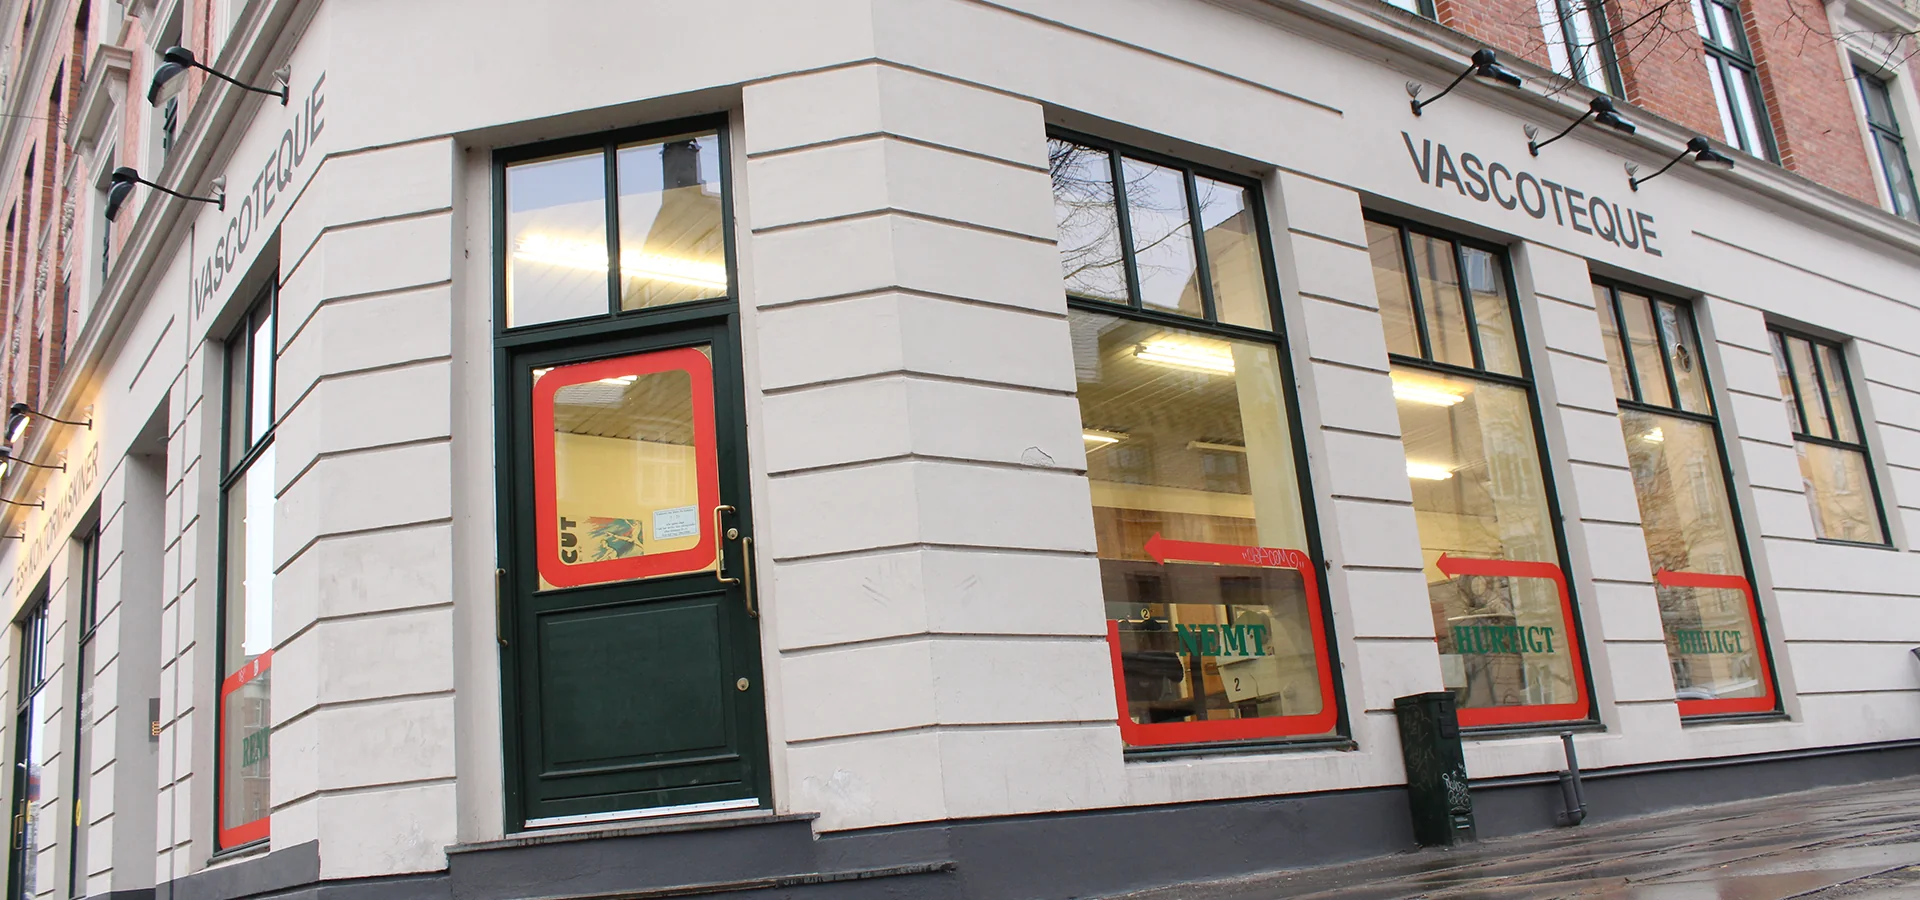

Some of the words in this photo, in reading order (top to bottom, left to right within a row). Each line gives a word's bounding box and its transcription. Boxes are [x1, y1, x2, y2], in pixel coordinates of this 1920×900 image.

[194, 70, 326, 321] VASCOTEQUE
[1400, 130, 1663, 257] VASCOTEQUE
[560, 516, 578, 564] CUT
[1142, 608, 1149, 618] 2
[1175, 623, 1267, 656] NEMT
[1454, 625, 1554, 654] HURTIGT
[1677, 629, 1743, 654] BILLIGT
[1234, 677, 1241, 692] 2
